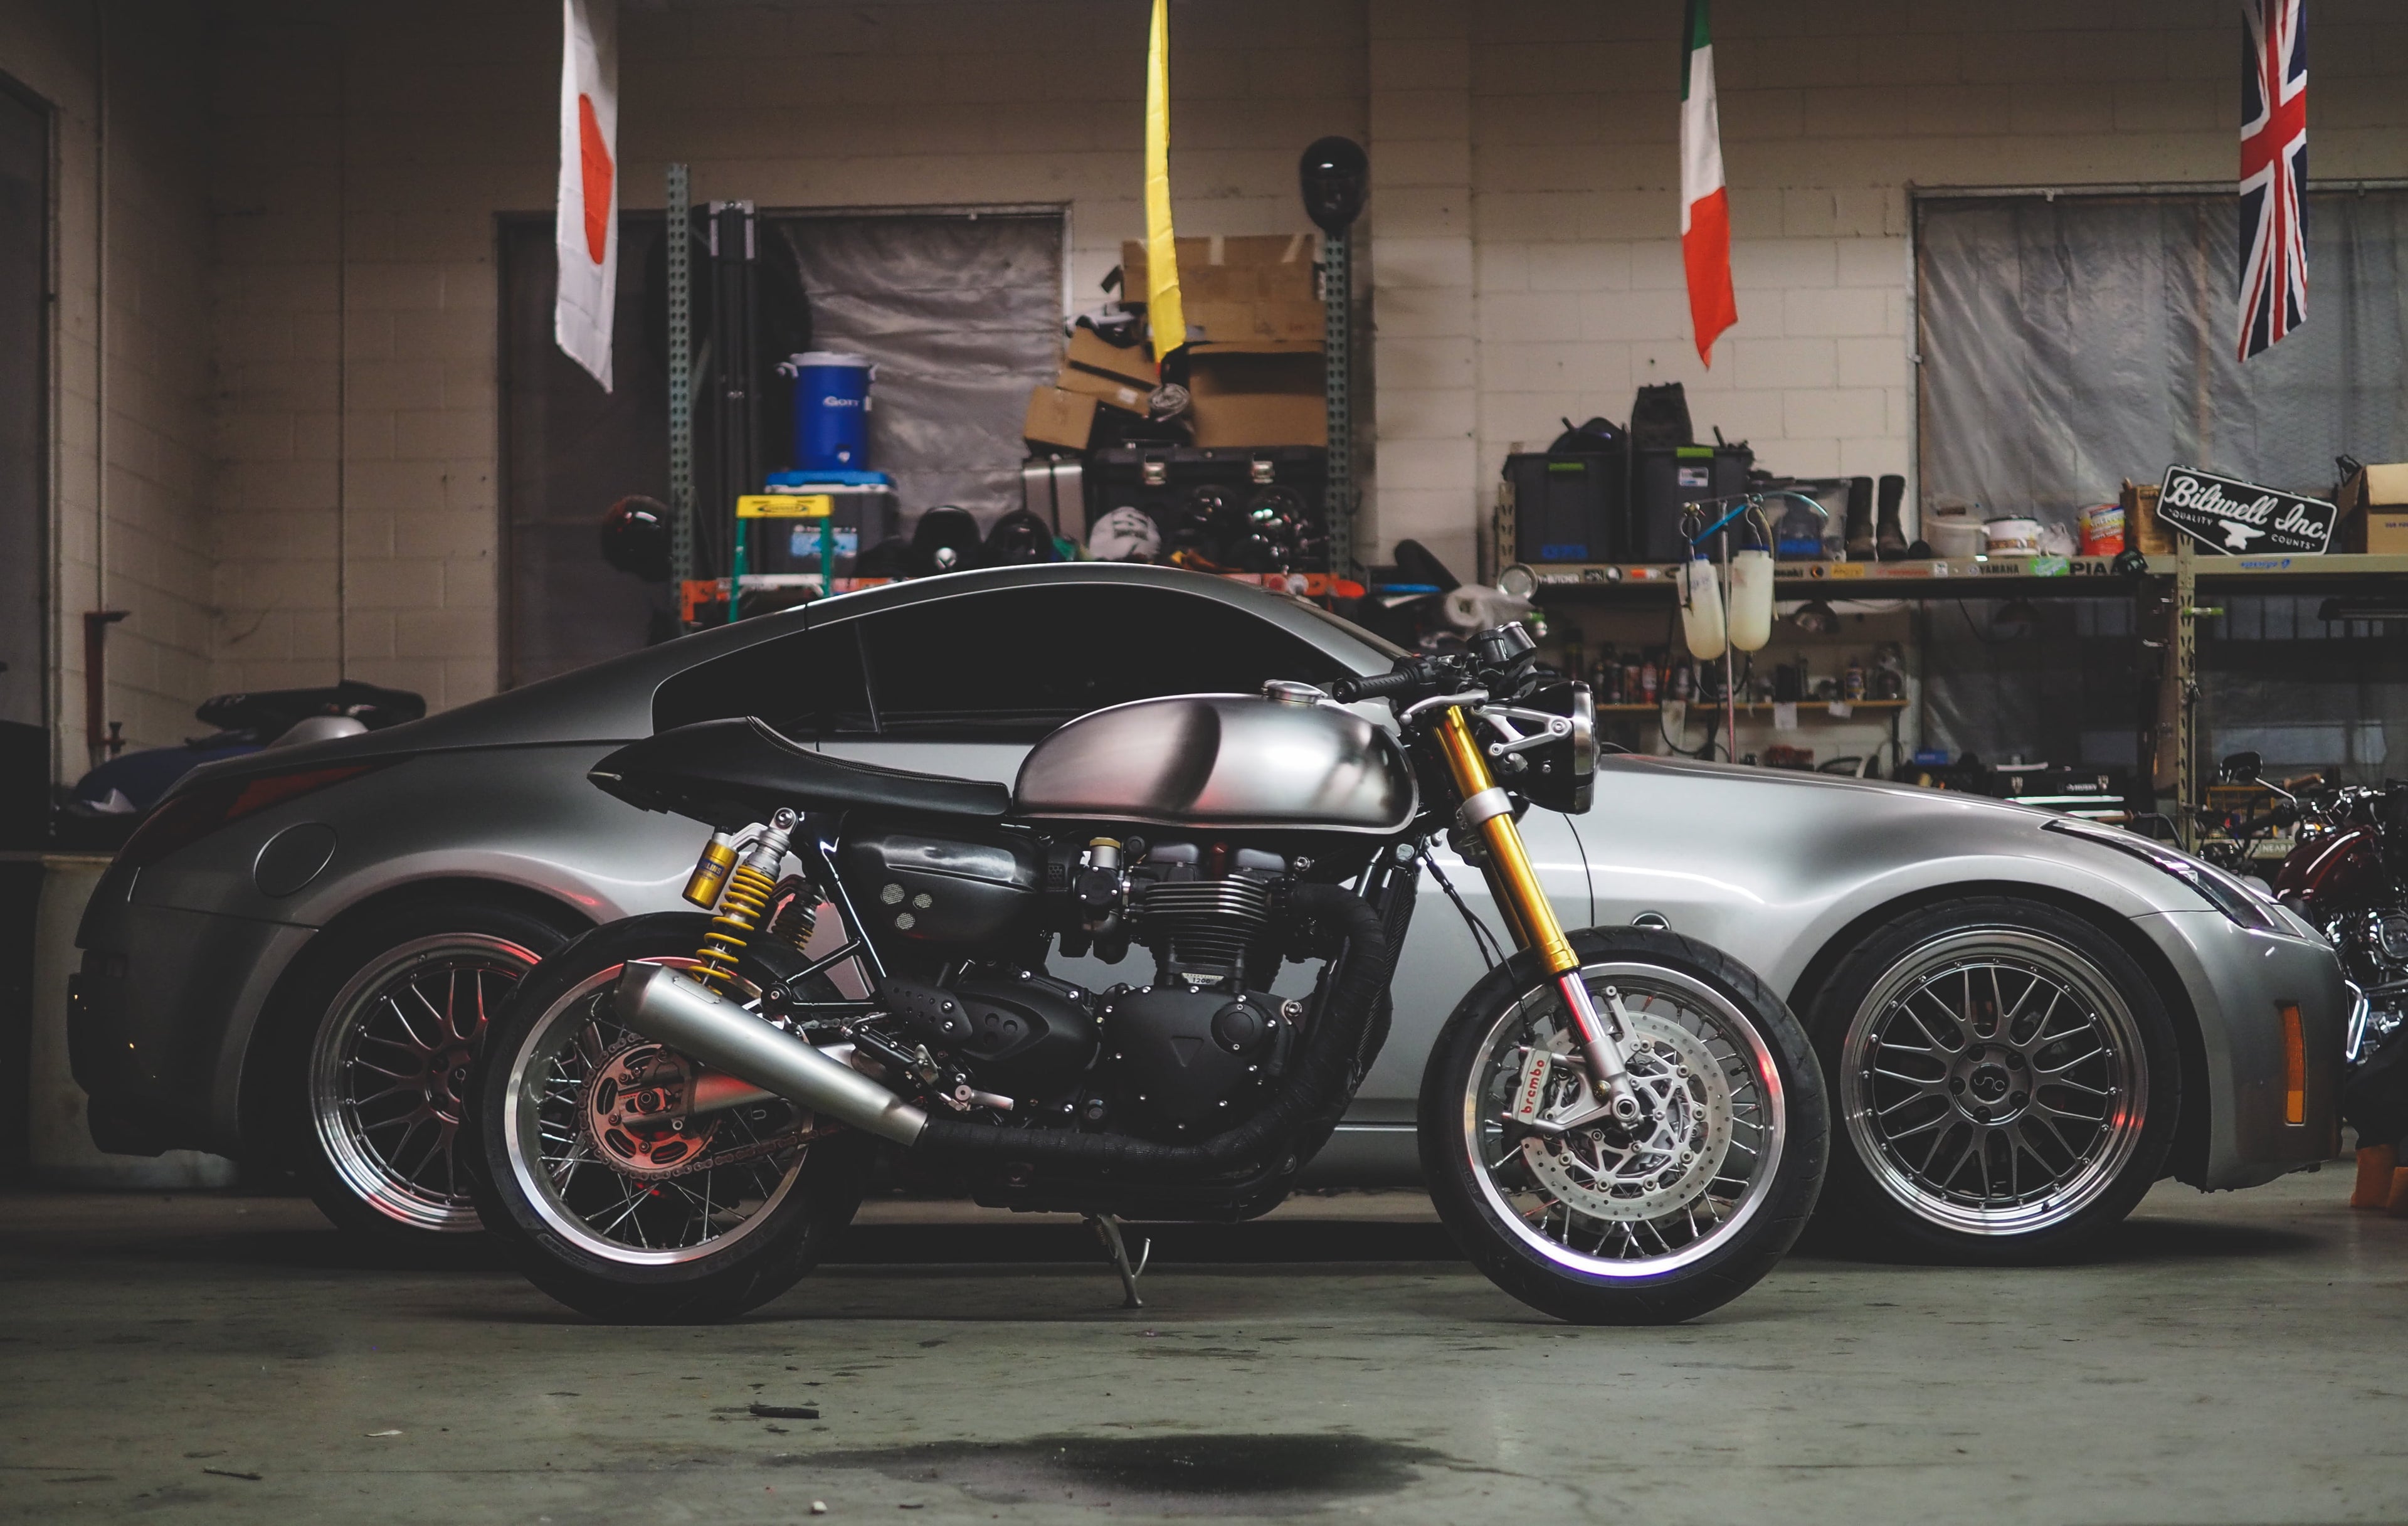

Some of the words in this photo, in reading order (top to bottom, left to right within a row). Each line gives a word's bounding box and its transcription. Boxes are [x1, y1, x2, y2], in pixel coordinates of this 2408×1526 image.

[2165, 476, 2278, 525] Biltwell
[2275, 504, 2328, 540] Inc.
[1980, 564, 2019, 574] YAMAHA
[1521, 1060, 1545, 1113] brembo
